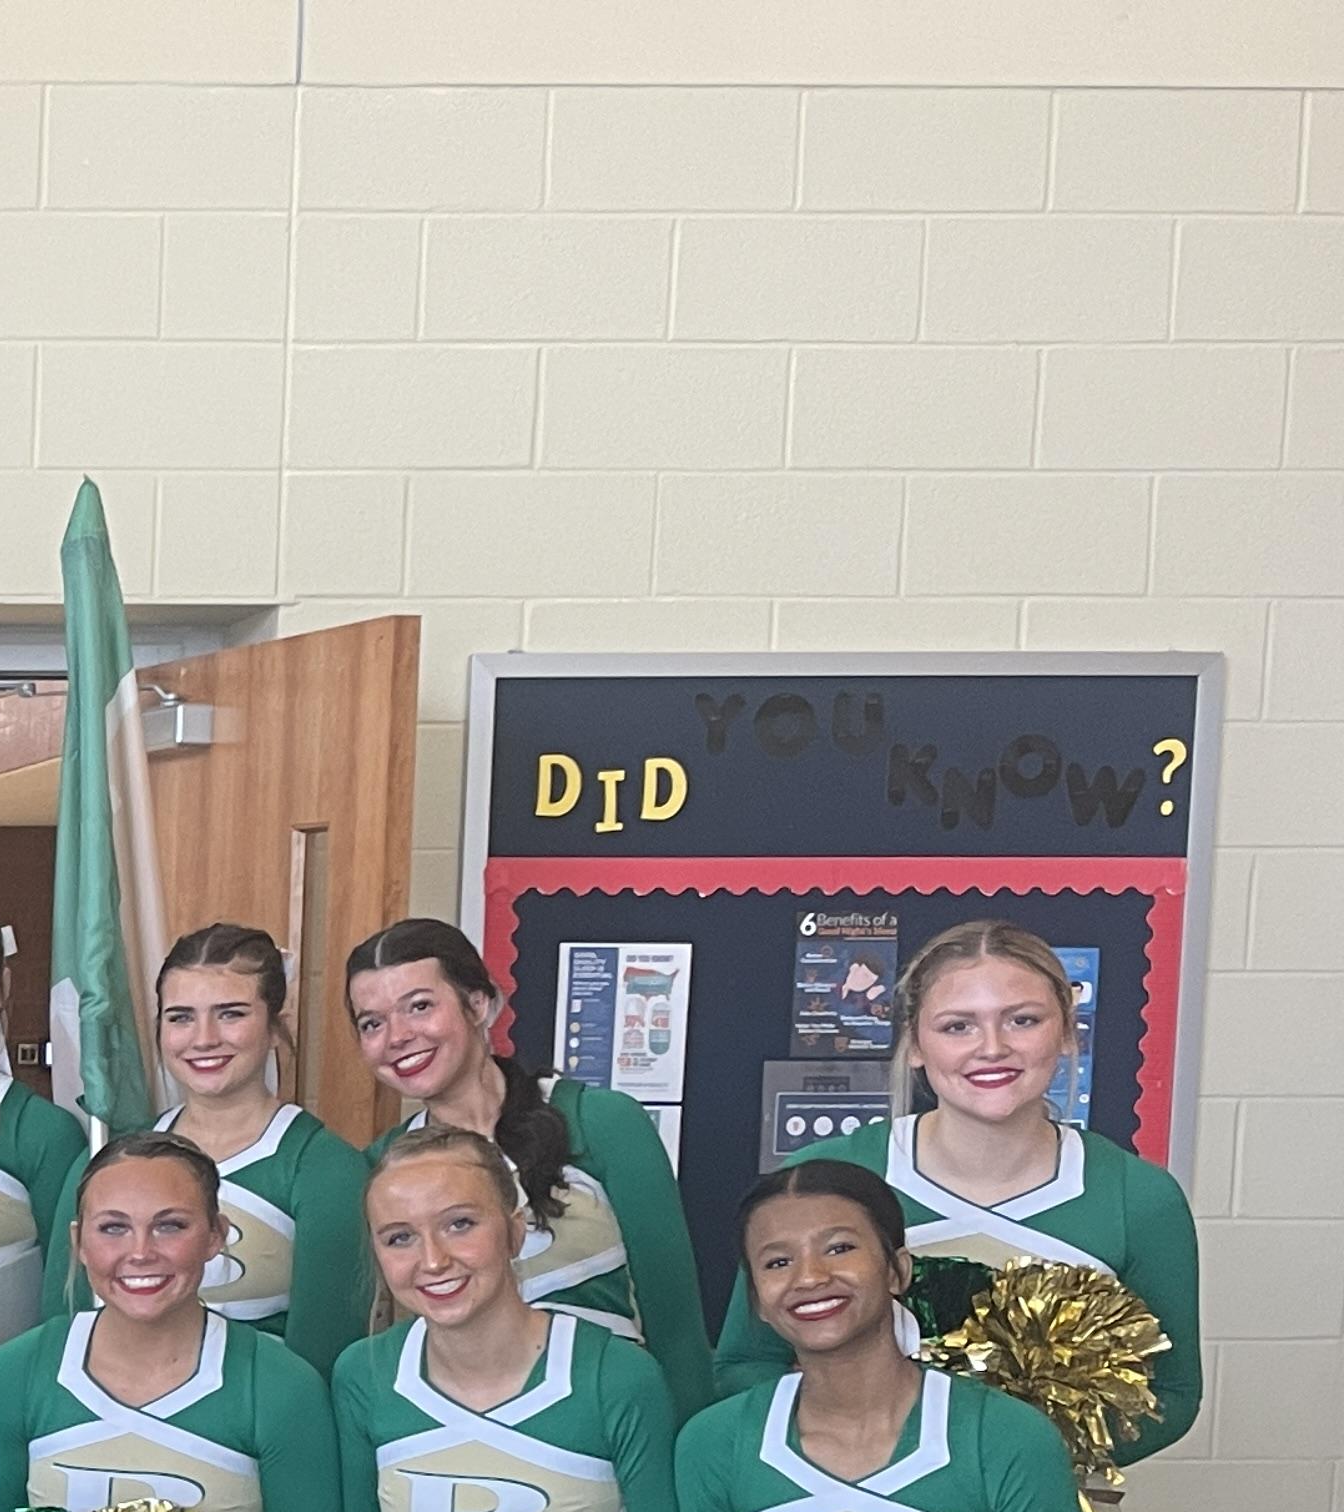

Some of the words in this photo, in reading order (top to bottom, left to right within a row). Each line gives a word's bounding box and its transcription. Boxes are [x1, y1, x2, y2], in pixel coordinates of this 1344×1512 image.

[535, 753, 688, 834] DID
[696, 692, 885, 760] YOU
[800, 912, 817, 936] 6
[817, 912, 870, 928] Benefits
[872, 912, 889, 926] of
[889, 916, 897, 927] a
